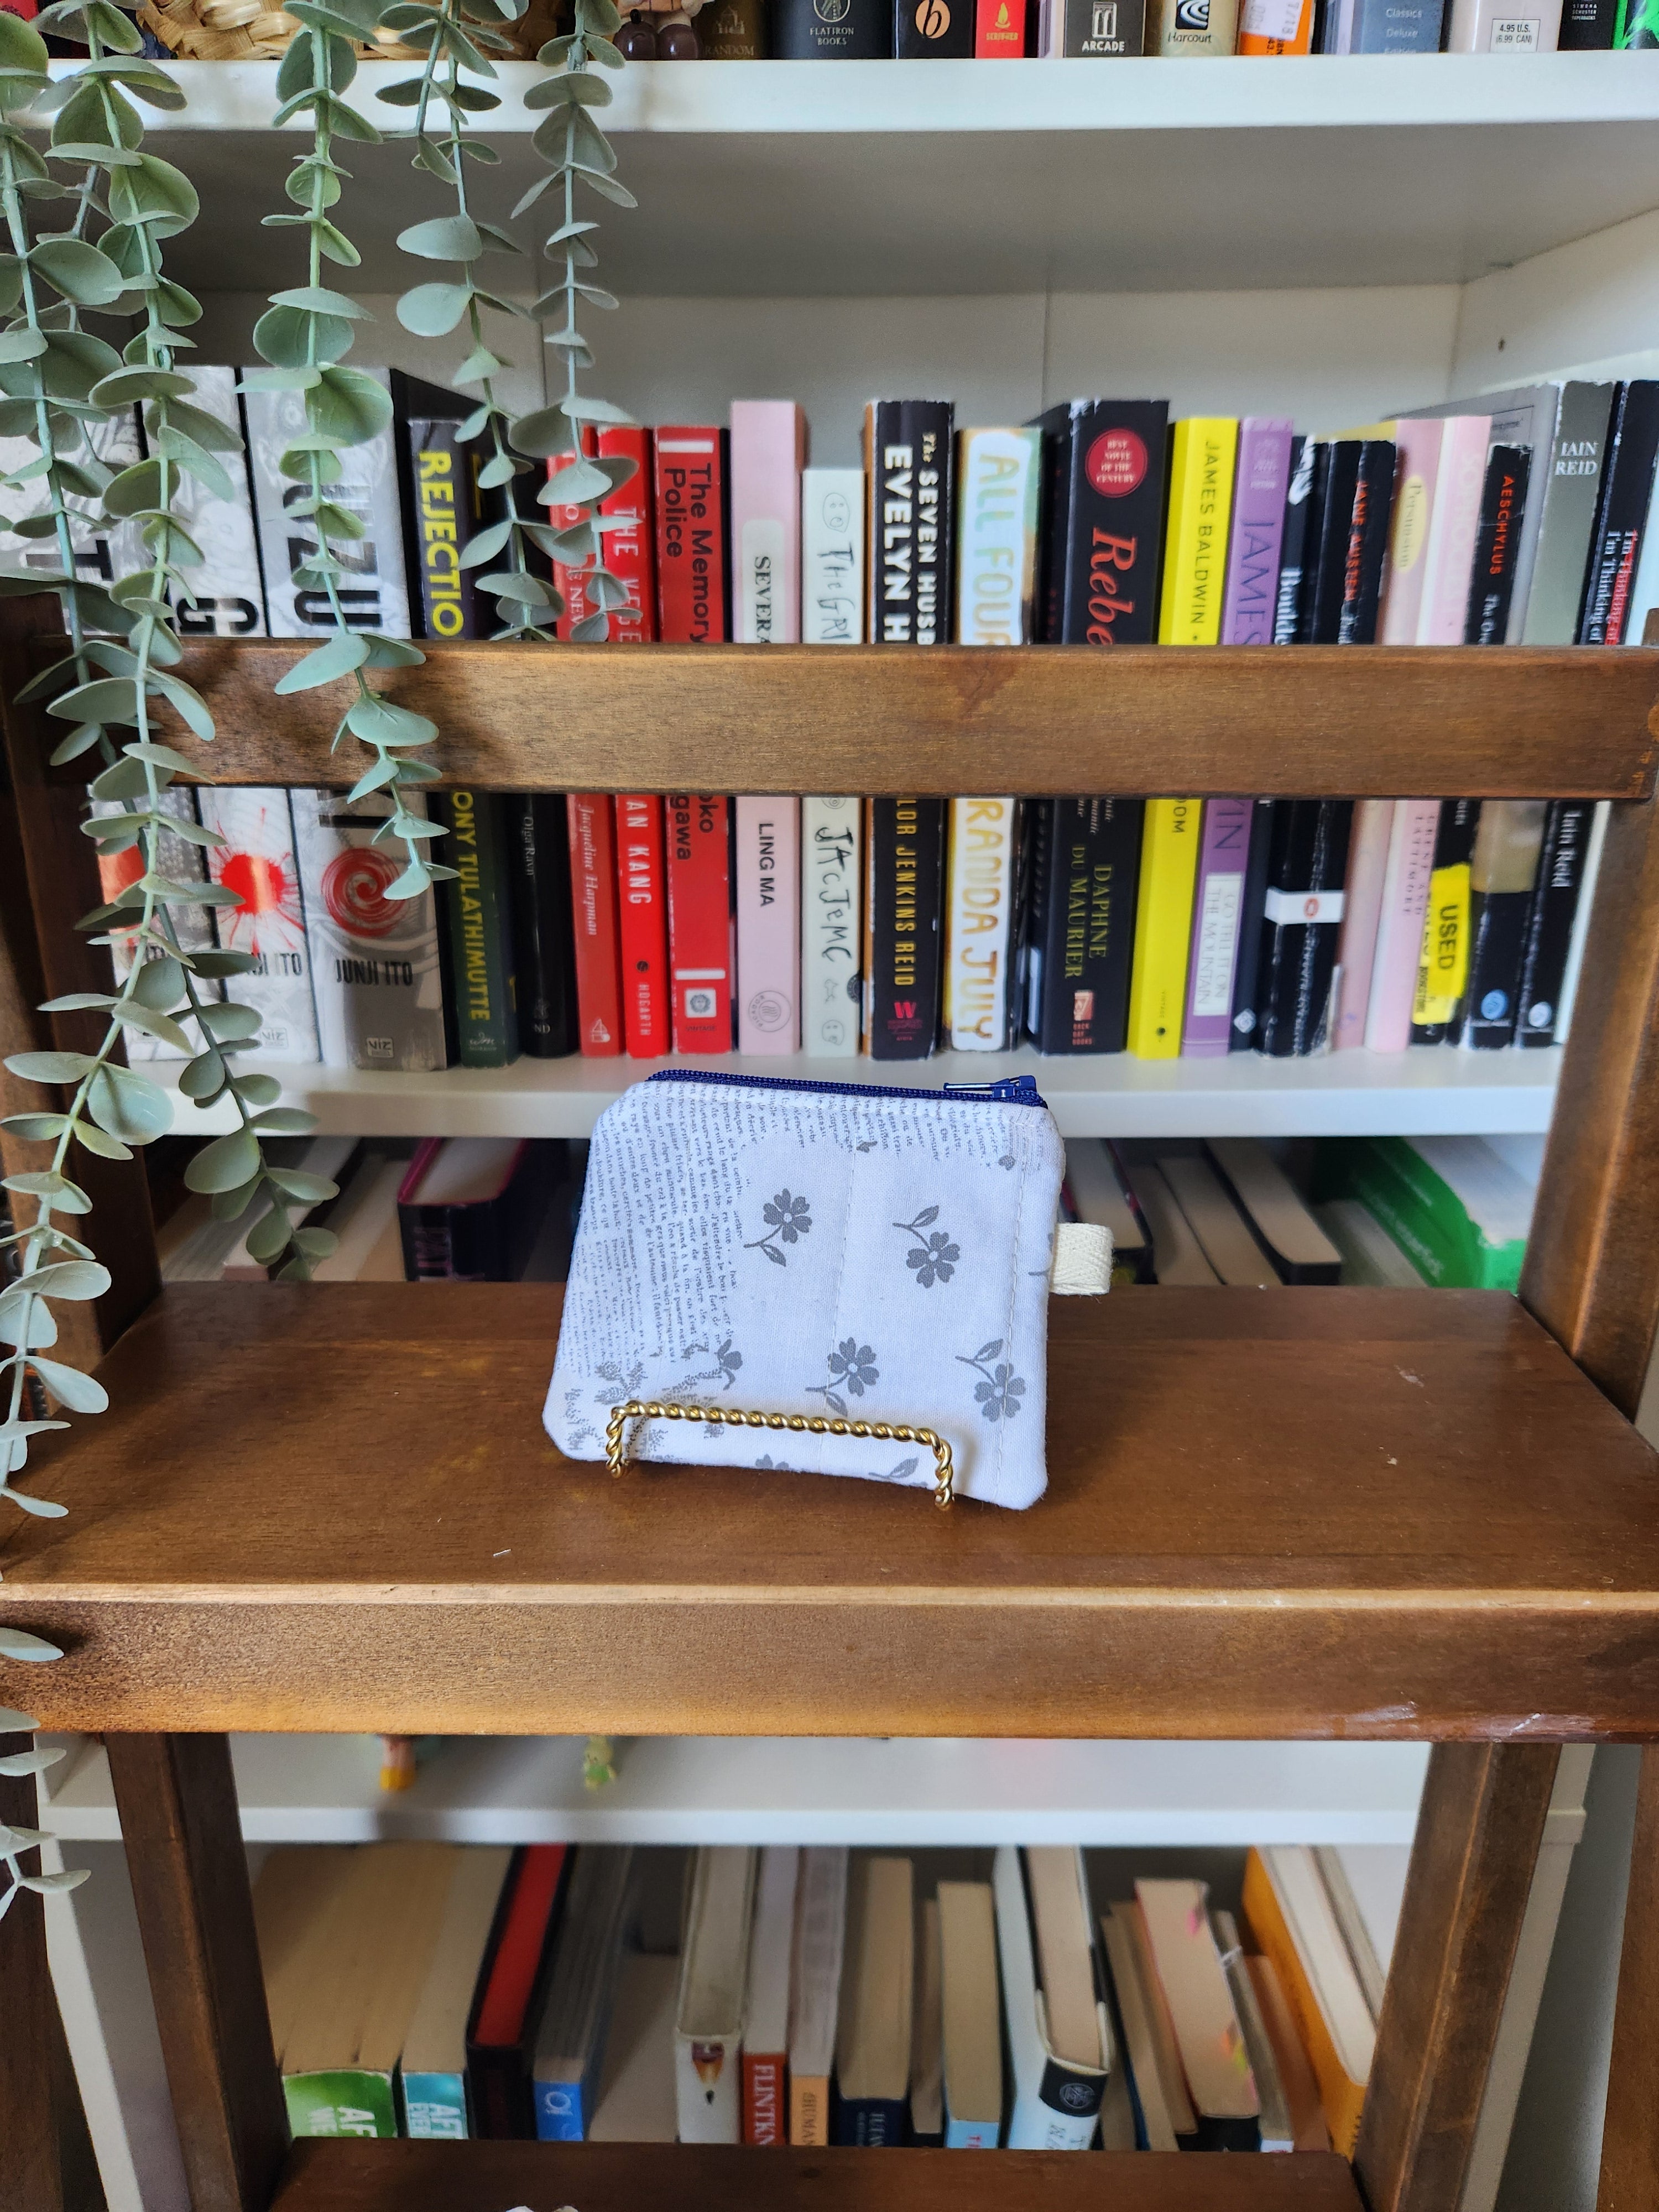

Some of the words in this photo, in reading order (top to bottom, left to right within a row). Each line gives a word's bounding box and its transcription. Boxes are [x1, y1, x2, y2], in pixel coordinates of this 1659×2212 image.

[809, 27, 854, 36] FLATIRON
[1386, 8, 1423, 18] Classics
[1386, 29, 1418, 38] Deluxe
[1499, 24, 1515, 33] 4.95
[1517, 24, 1531, 33] U.S.
[705, 45, 755, 56] RANDOM
[817, 37, 847, 46] BOOKS
[1082, 41, 1125, 52] ARCADE
[1168, 32, 1212, 44] Harcourt
[1495, 35, 1513, 44] (6.99
[1516, 35, 1532, 44] CAN)
[921, 431, 937, 463] The
[1555, 460, 1598, 476] REID
[1561, 441, 1598, 457] IAIN
[689, 462, 713, 520] The
[973, 453, 1020, 533] ALL
[1199, 440, 1221, 515] JAMES
[664, 468, 688, 559] Police
[884, 445, 914, 602] EVELYN
[918, 471, 939, 564] SEVEN
[1352, 481, 1369, 526] JANE
[1489, 475, 1515, 575] AESCHYLUS
[418, 449, 465, 638] REJECTIO
[688, 529, 714, 644] Memory
[1190, 525, 1215, 625] BALDWIN
[1344, 533, 1364, 602] AUSTEN
[523, 816, 535, 846] Olga
[626, 801, 649, 828] AN
[670, 795, 692, 860] gawa
[579, 804, 598, 872] Jacqueline
[758, 822, 775, 870] LING
[1070, 844, 1087, 871] DU
[524, 847, 536, 877] Ravn
[628, 845, 652, 904] KANG
[582, 875, 598, 936] Harpman
[759, 877, 775, 908] MA
[895, 846, 917, 932] JENKINS
[1206, 888, 1221, 916] THE
[1223, 894, 1236, 919] GO
[1065, 877, 1088, 980] MAURIER
[1088, 864, 1113, 959] DAPHNE
[458, 854, 491, 1022] TULATHIMUTTE
[1218, 923, 1233, 952] TELL
[1437, 904, 1459, 971] USED
[336, 958, 378, 985] JUNJI
[384, 959, 414, 985] ITO
[894, 942, 916, 986] REID
[1197, 921, 1218, 1005] MOUNTAIN
[1217, 957, 1230, 969] IT
[957, 946, 998, 1040] JULY
[1214, 974, 1228, 999] ON
[534, 1022, 551, 1034] ND
[638, 984, 652, 1036] HOGARTH
[751, 994, 765, 1027] PICADOR
